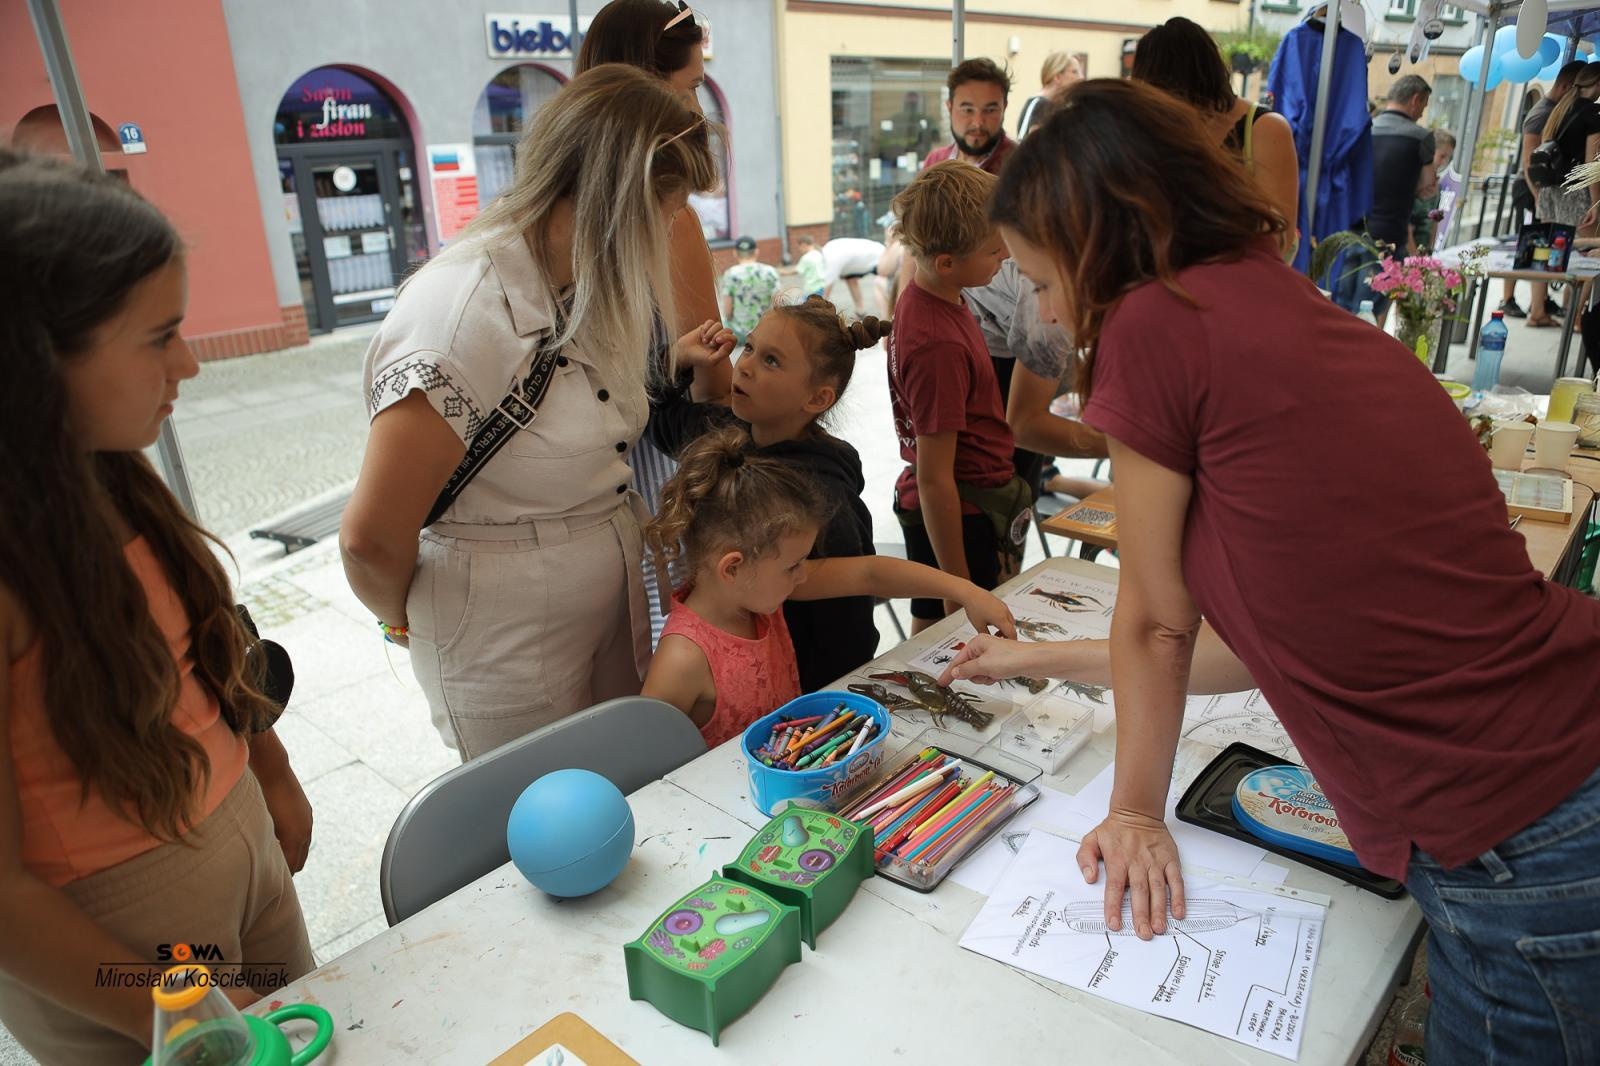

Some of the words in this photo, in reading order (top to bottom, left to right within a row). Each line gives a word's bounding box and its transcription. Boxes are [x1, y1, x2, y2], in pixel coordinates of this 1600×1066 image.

[316, 97, 372, 129] firan
[124, 128, 139, 140] 16
[297, 120, 304, 138] i
[541, 350, 555, 371] OLO
[523, 374, 542, 401] CLUB
[472, 416, 514, 457] BEVERLY
[1258, 792, 1339, 827] Kolorow
[1270, 1007, 1288, 1041] PANCERZA
[1284, 1015, 1300, 1042] BUDOWA
